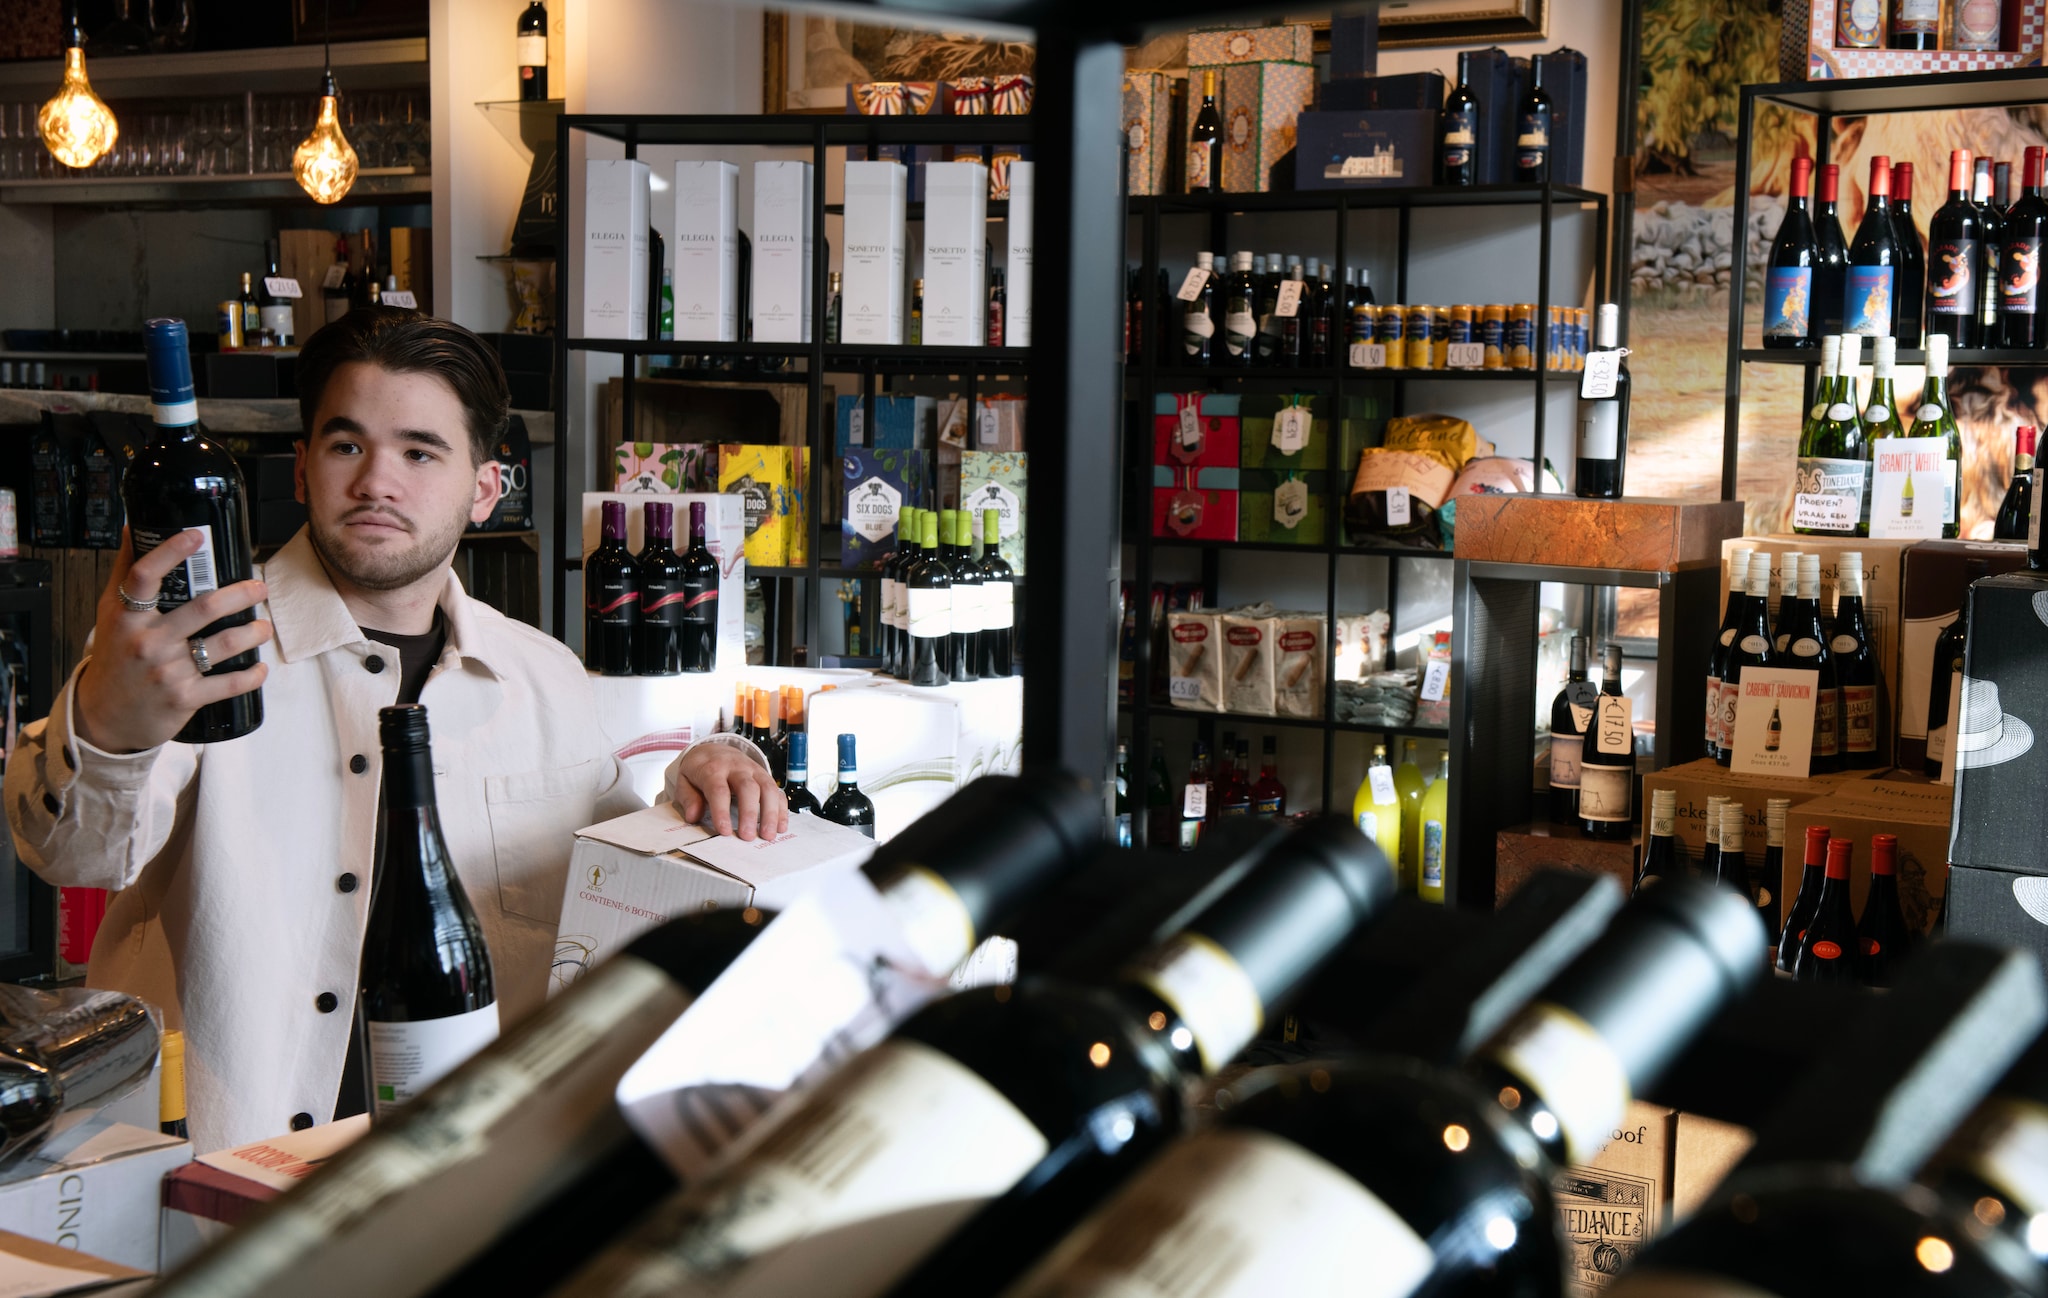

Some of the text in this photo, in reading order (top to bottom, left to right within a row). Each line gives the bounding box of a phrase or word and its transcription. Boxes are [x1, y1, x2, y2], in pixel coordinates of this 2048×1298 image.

[591, 232, 625, 241] ELEGIA
[680, 233, 716, 242] ELEGIA
[759, 234, 795, 243] ELEGIA
[847, 244, 886, 254] SONETTO
[928, 246, 967, 255] SONETTO
[1352, 344, 1380, 365] €1.50
[1449, 345, 1478, 365] €1.50
[1879, 452, 1941, 473] GRANITE WHITE
[746, 499, 767, 510] DOGS
[856, 504, 893, 515] SIX DOGS
[865, 522, 883, 531] BLUE
[1171, 682, 1200, 696] €5.00
[1745, 682, 1811, 699] CABERNET SAUVIGNON
[1604, 700, 1625, 746] €17.50
[579, 890, 625, 912] CONTIENE
[624, 904, 631, 913] 6
